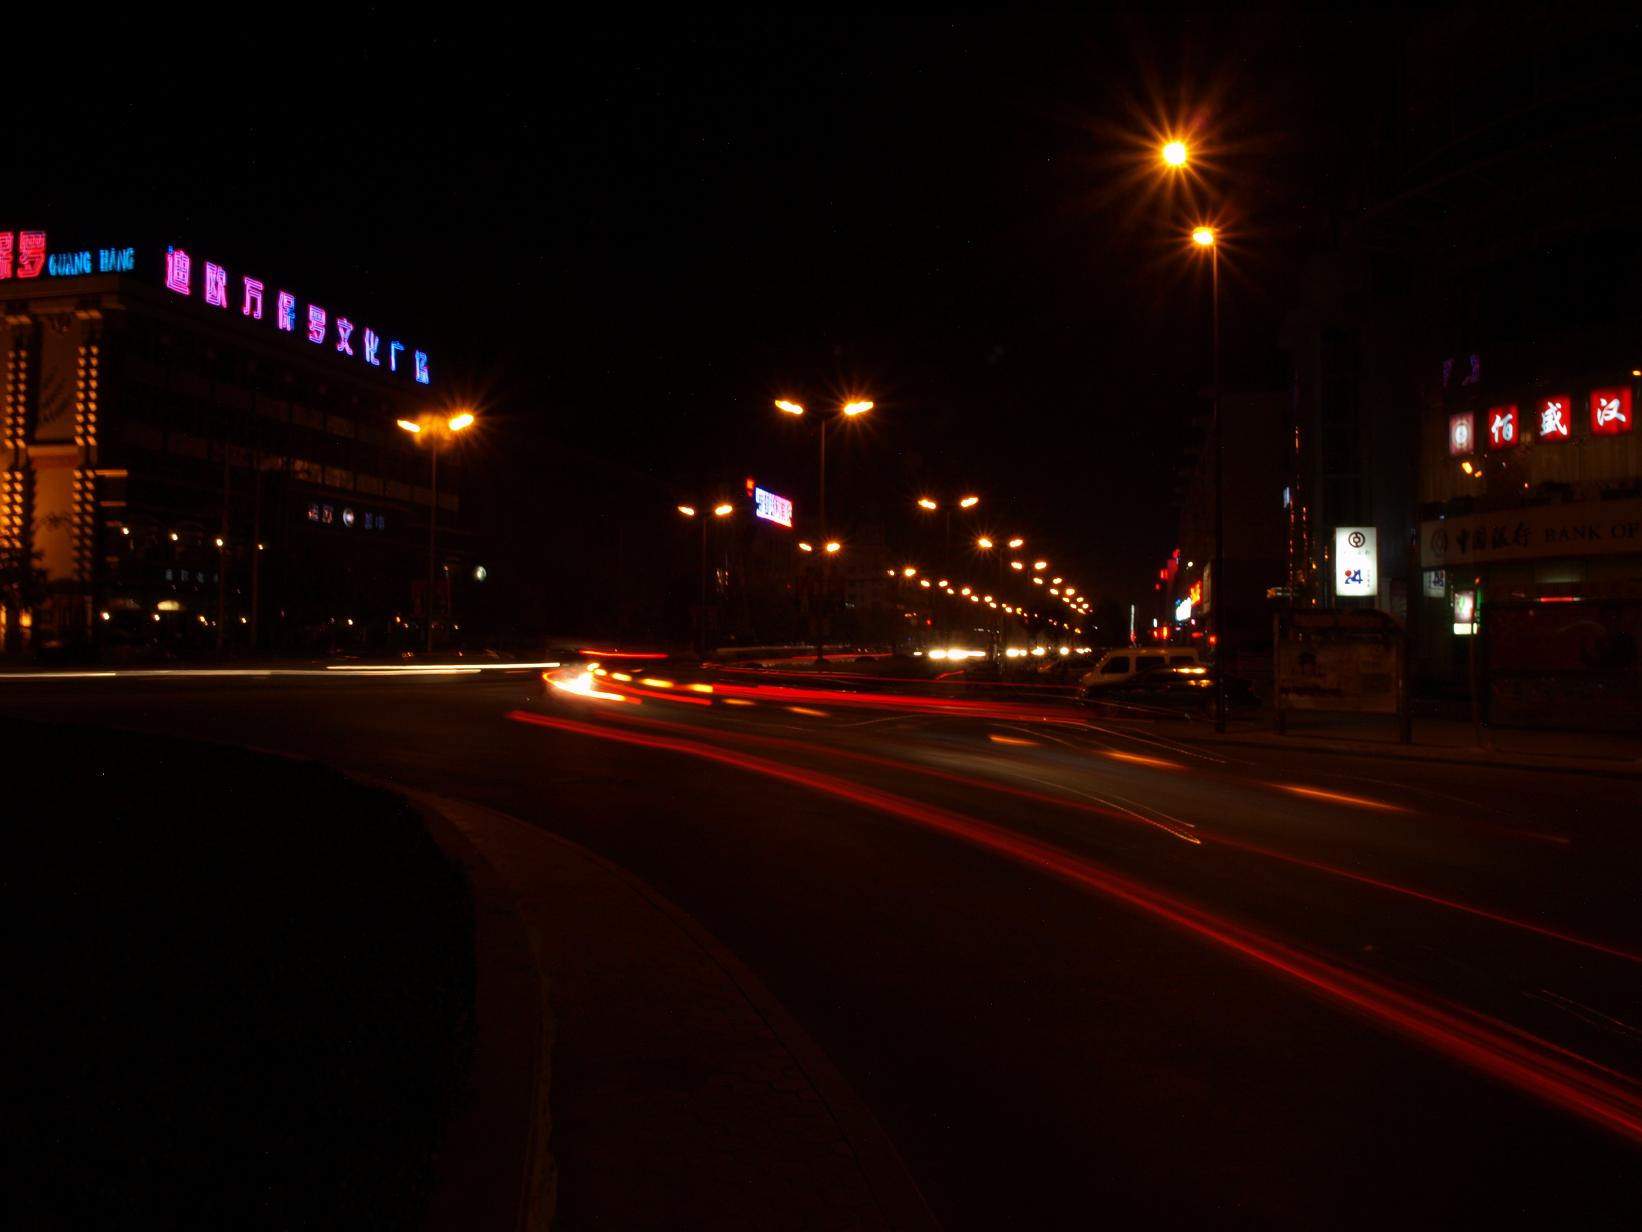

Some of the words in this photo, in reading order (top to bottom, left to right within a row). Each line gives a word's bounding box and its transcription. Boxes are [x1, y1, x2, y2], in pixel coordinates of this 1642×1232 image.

[48, 251, 92, 276] GUANG
[1544, 524, 1601, 544] BANK
[1610, 520, 1641, 539] OF
